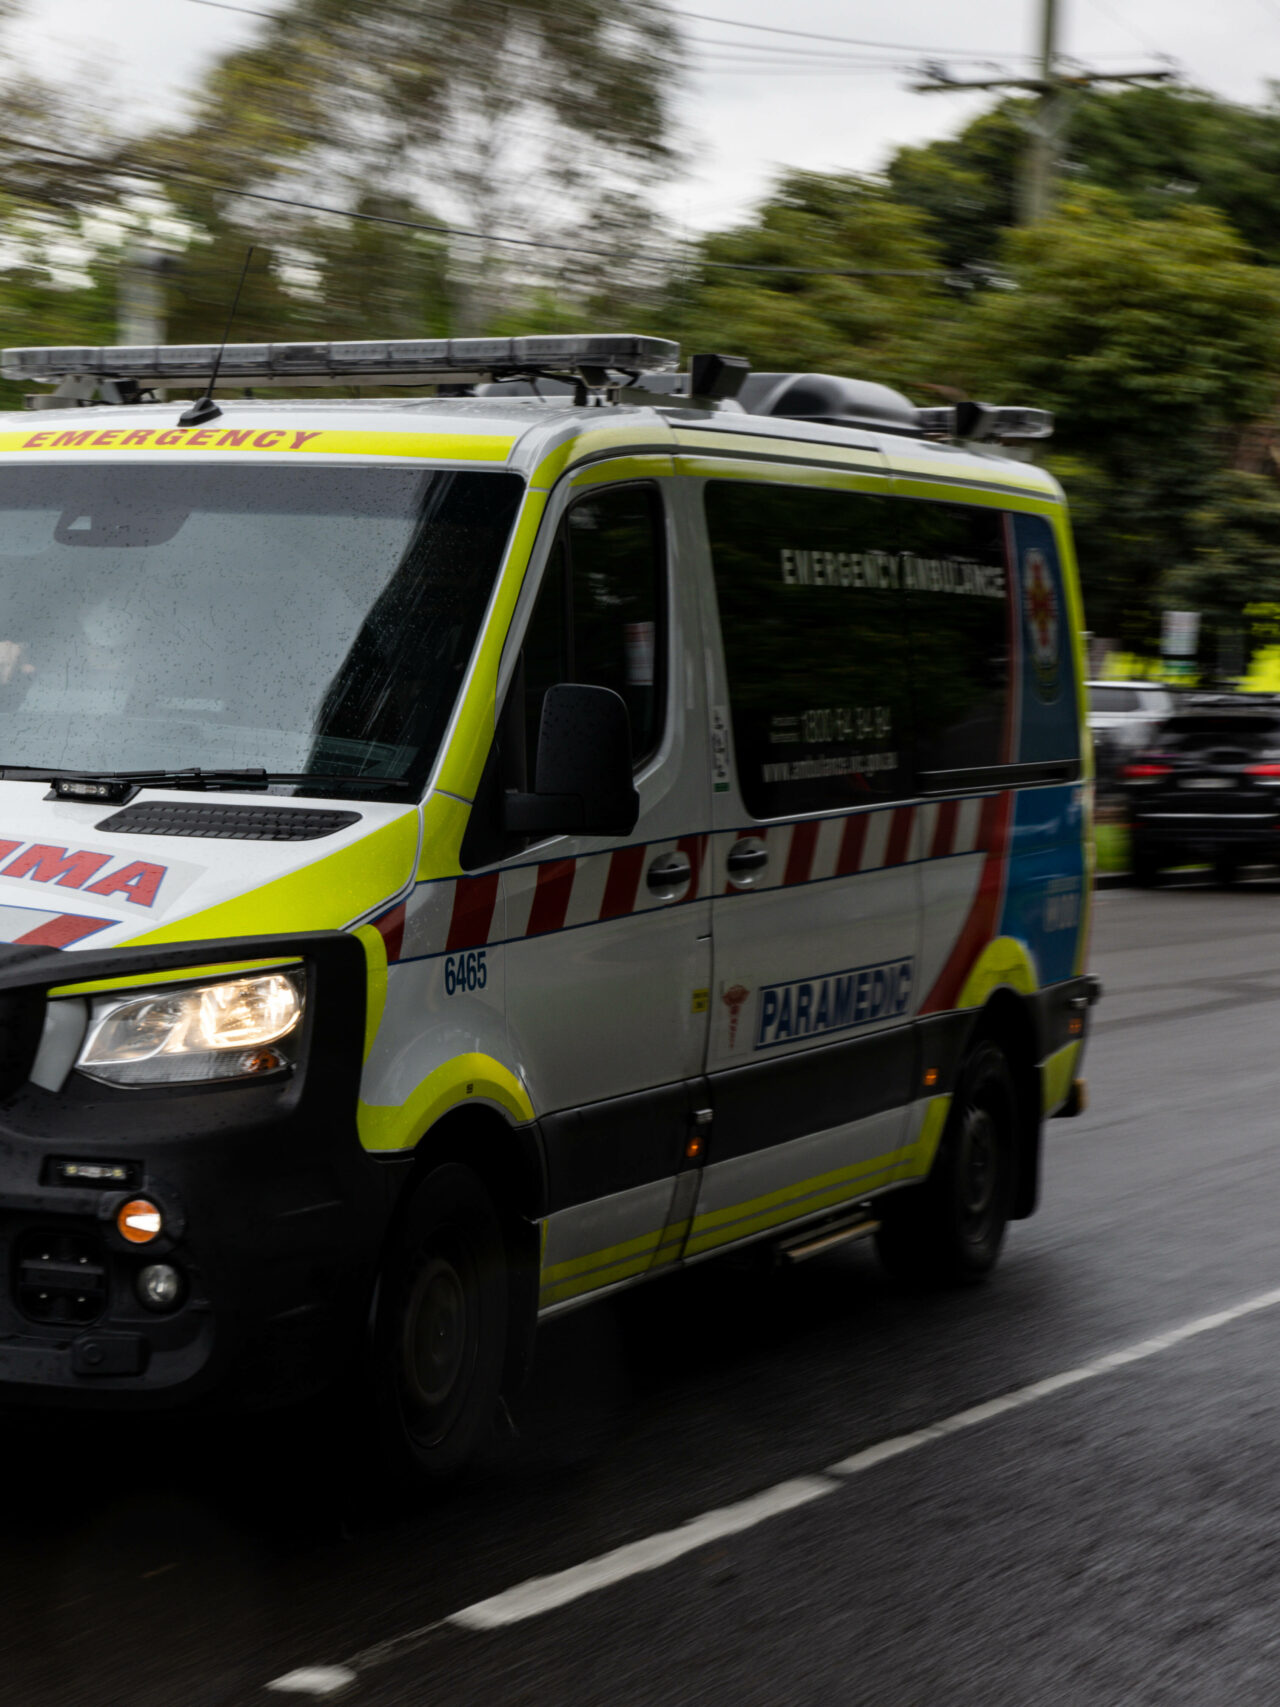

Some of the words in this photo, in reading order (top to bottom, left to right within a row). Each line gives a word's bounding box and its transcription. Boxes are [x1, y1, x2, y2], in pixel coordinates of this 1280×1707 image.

[22, 429, 324, 450] EMERGENCY
[445, 951, 487, 995] 6465
[760, 964, 912, 1042] PARAMEDIC
